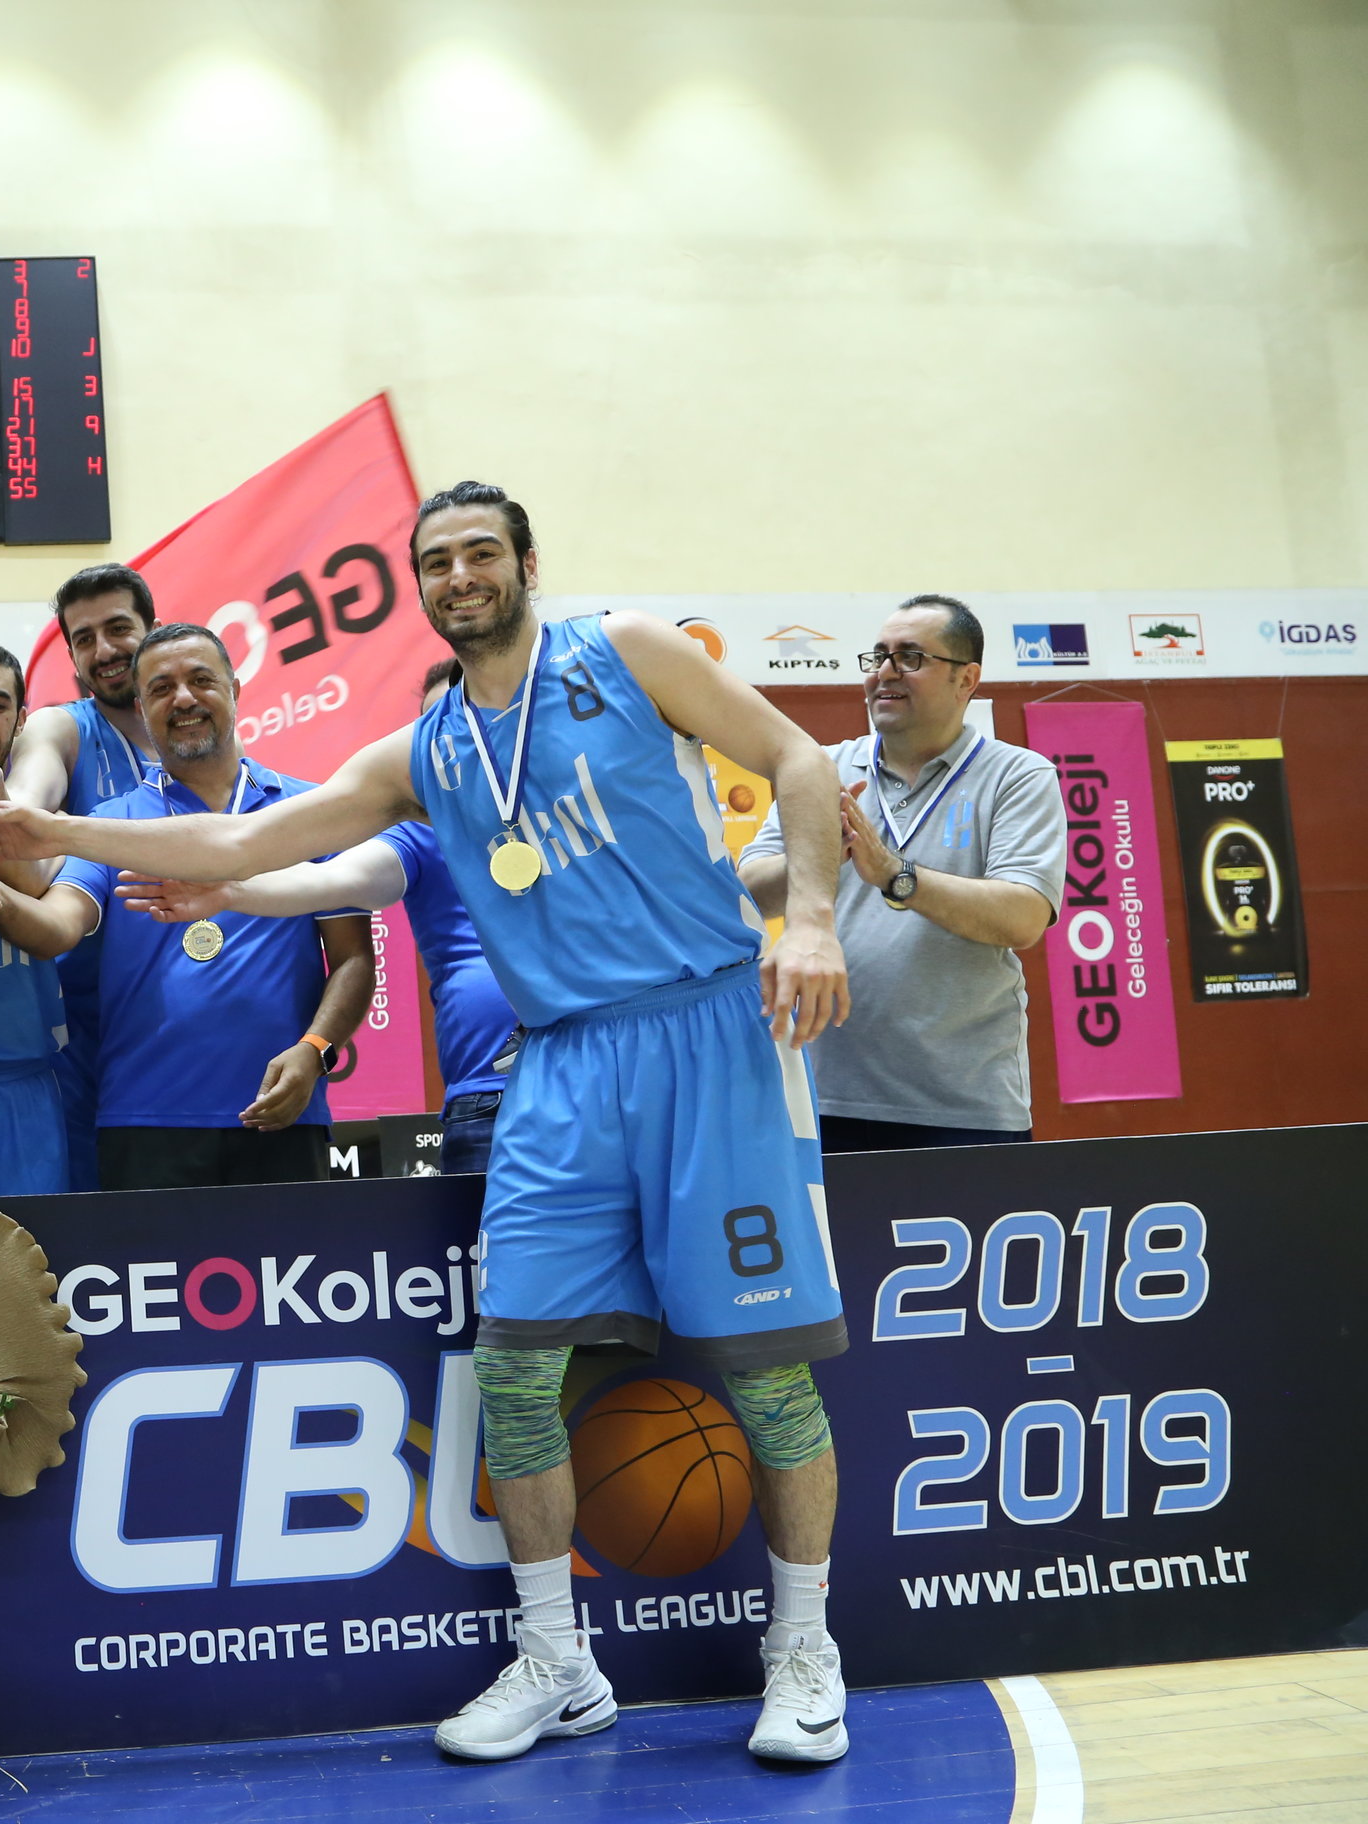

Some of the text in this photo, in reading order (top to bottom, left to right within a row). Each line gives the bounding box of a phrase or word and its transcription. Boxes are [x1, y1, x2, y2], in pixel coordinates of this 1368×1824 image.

[15, 298, 29, 318] 8
[10, 337, 31, 357] 10
[1278, 620, 1357, 643] İGDAŞ
[561, 661, 605, 721] 8
[1207, 765, 1241, 775] DANONE
[1112, 799, 1147, 998] Geleceğin Okulu
[1205, 982, 1233, 995] SIFIR
[416, 1133, 443, 1148] SPO
[723, 1205, 783, 1277] 8
[872, 1201, 1210, 1342] 2018
[741, 1290, 780, 1306] AND
[892, 1388, 1231, 1536] 2019
[900, 1546, 1249, 1610] www.cbl.com.tr
[74, 1621, 328, 1672] CORPORATE
[615, 1588, 767, 1633] LEAGUE
